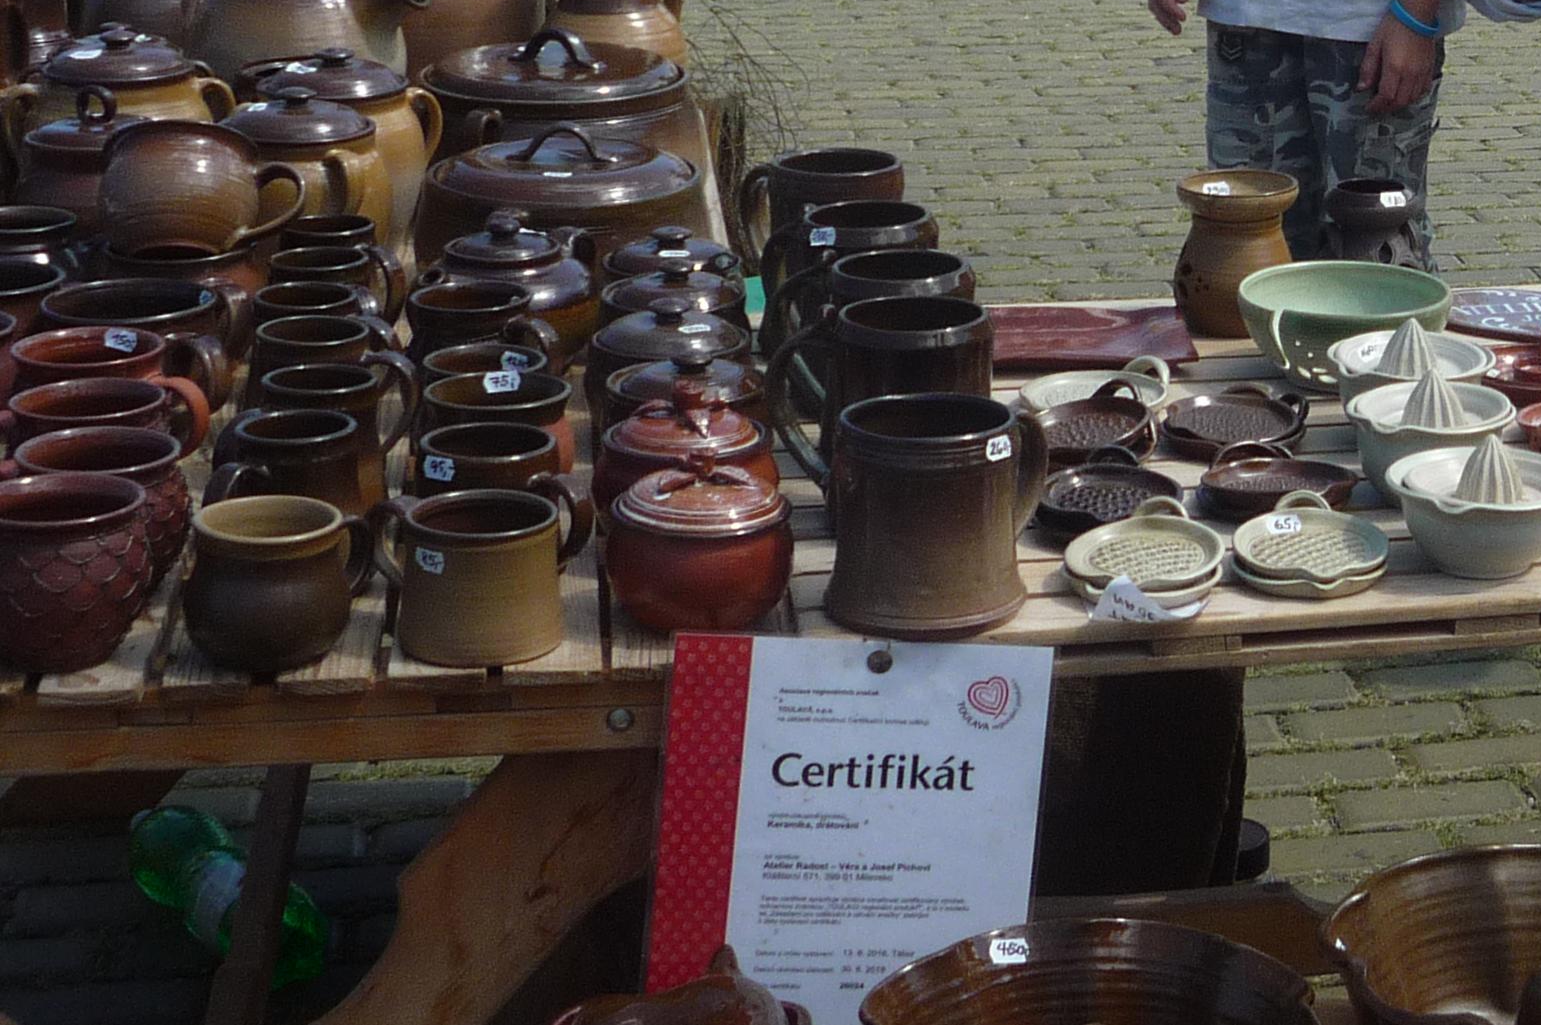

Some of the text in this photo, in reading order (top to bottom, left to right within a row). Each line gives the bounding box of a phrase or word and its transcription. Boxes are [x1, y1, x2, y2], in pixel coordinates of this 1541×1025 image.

[771, 752, 975, 792] Certifikát
[763, 860, 794, 870] Atelier
[796, 861, 828, 871] Radost
